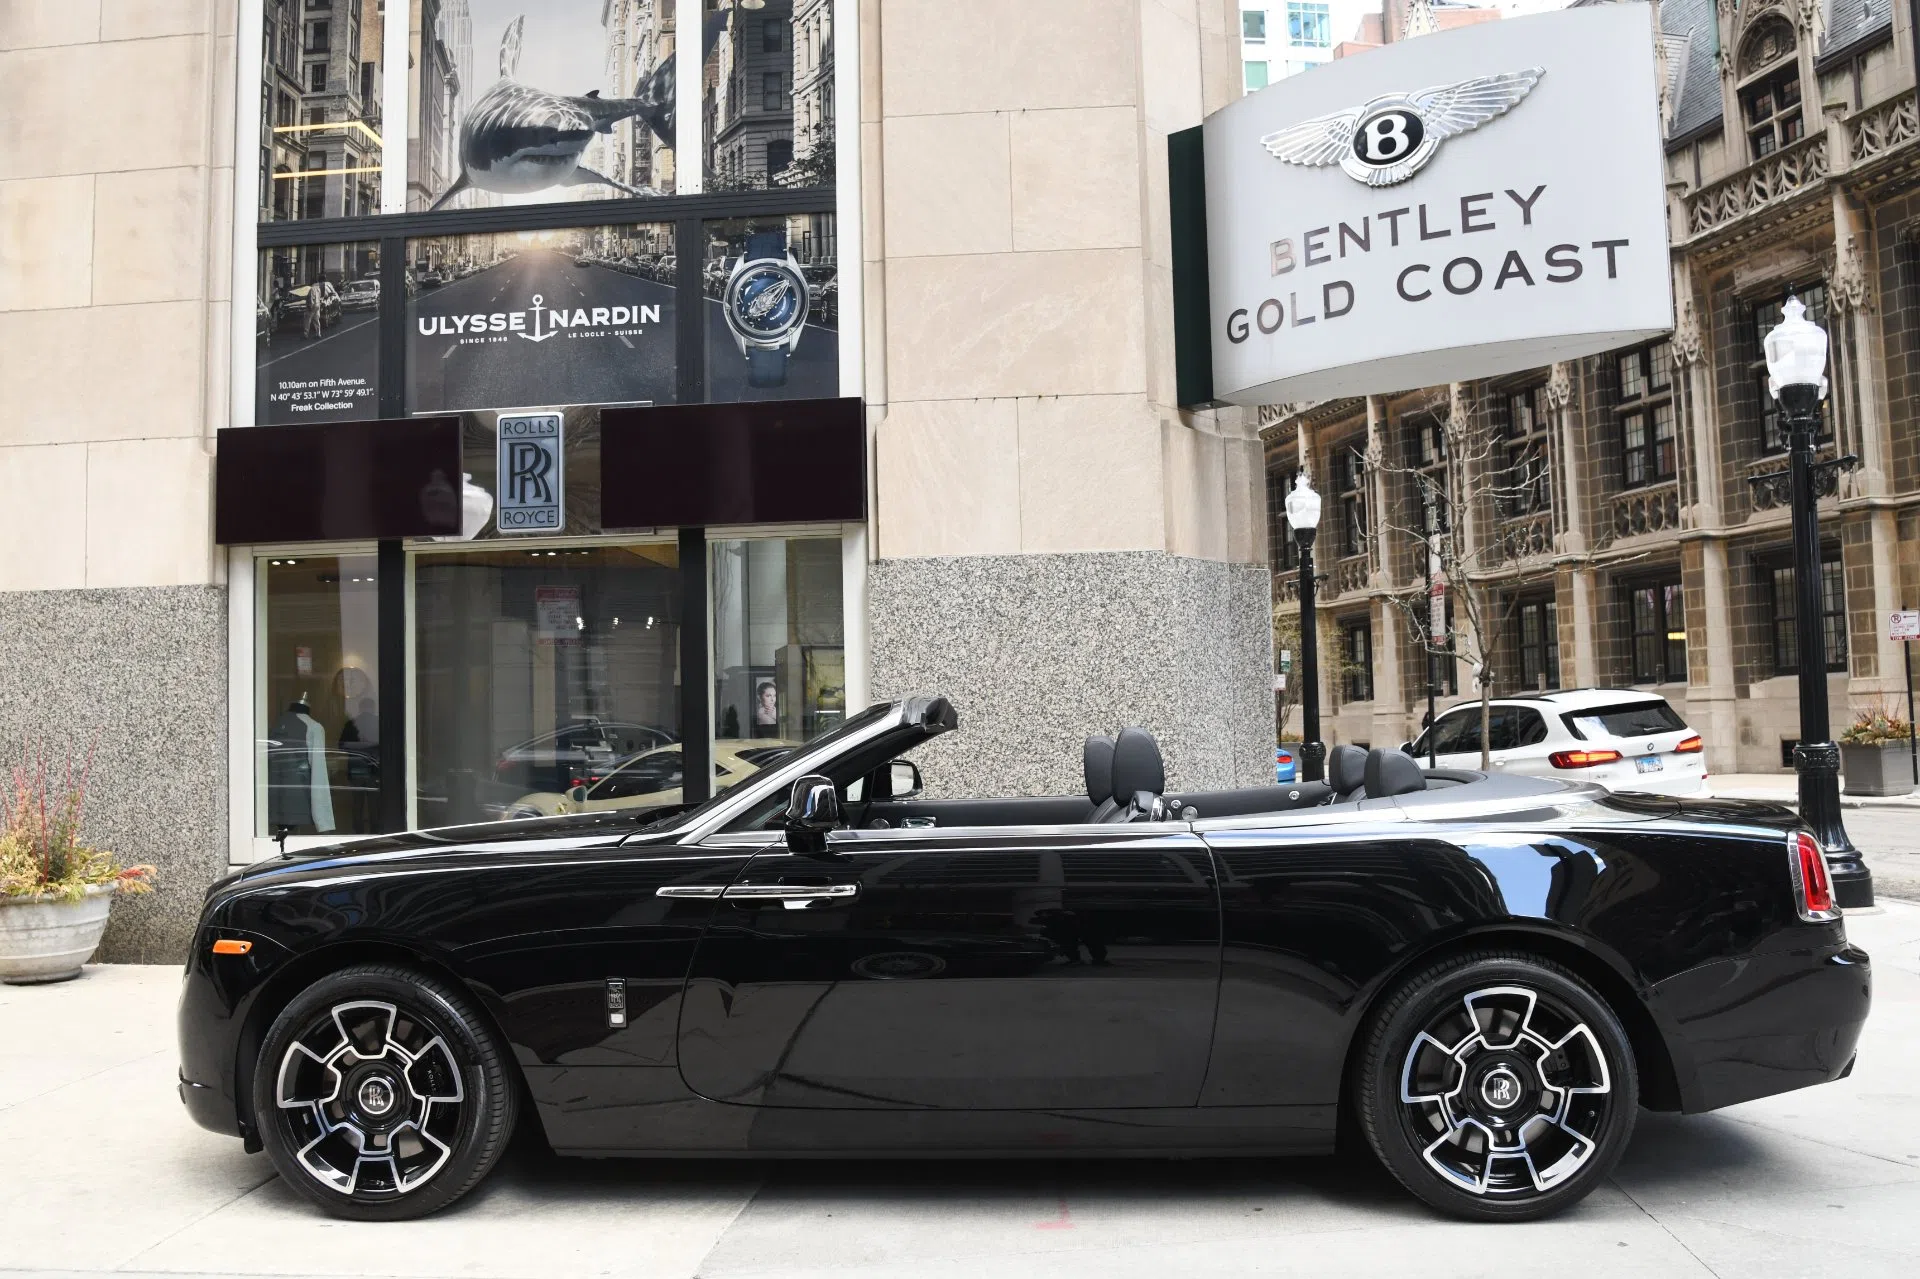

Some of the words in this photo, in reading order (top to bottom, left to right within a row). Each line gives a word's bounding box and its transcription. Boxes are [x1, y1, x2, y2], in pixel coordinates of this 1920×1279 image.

[1364, 113, 1411, 160] B
[1270, 184, 1548, 278] BENTLEY
[1226, 280, 1355, 345] GOLD
[1396, 239, 1630, 303] COAST
[418, 311, 526, 336] ULYSSE
[549, 304, 661, 329] NARDIN
[278, 393, 290, 401] 40°
[331, 390, 343, 398] 73°
[279, 381, 307, 390] 10.10am
[308, 380, 318, 388] on
[320, 378, 336, 387] Fifth
[337, 378, 367, 386] Avenue.
[291, 403, 313, 411] Freak
[314, 402, 353, 410] Collection
[504, 420, 555, 435] ROLLS
[508, 442, 553, 504] RR
[504, 510, 555, 524] ROYCE
